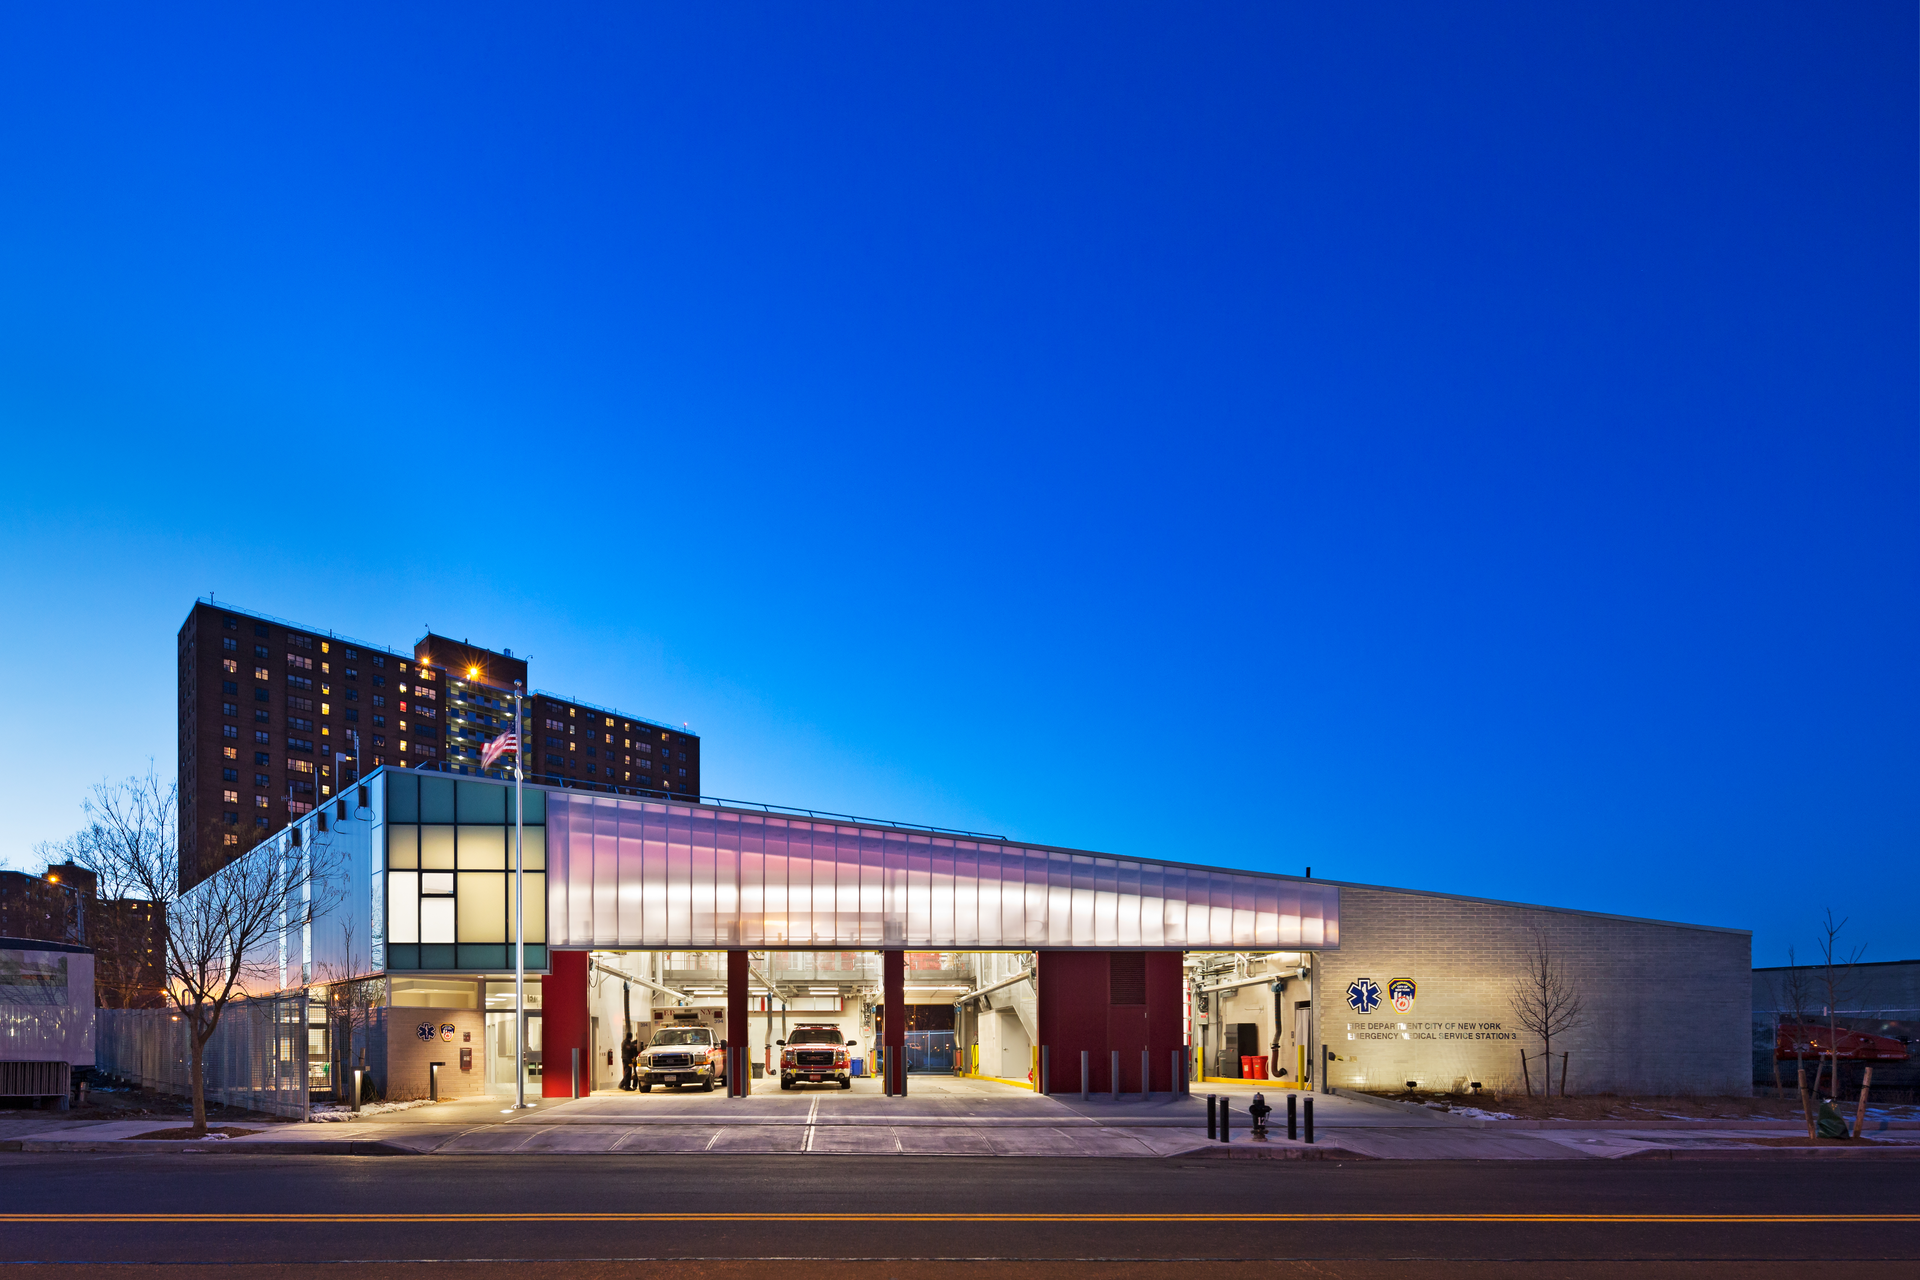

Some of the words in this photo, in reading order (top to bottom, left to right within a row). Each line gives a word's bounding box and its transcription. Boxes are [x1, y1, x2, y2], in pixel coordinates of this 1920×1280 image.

[1347, 1022, 1366, 1030] FIRE
[1368, 1022, 1423, 1030] DEPARTMENT
[1424, 1022, 1443, 1030] CITY
[1445, 1022, 1456, 1030] OF
[1457, 1022, 1477, 1030] NEW
[1478, 1022, 1501, 1030] YORK
[1347, 1032, 1398, 1040] EMERGENCY
[1400, 1032, 1437, 1040] MEDICAL
[1438, 1032, 1473, 1040] SERVICE
[1475, 1032, 1510, 1040] STATION
[1511, 1032, 1517, 1040] 3
